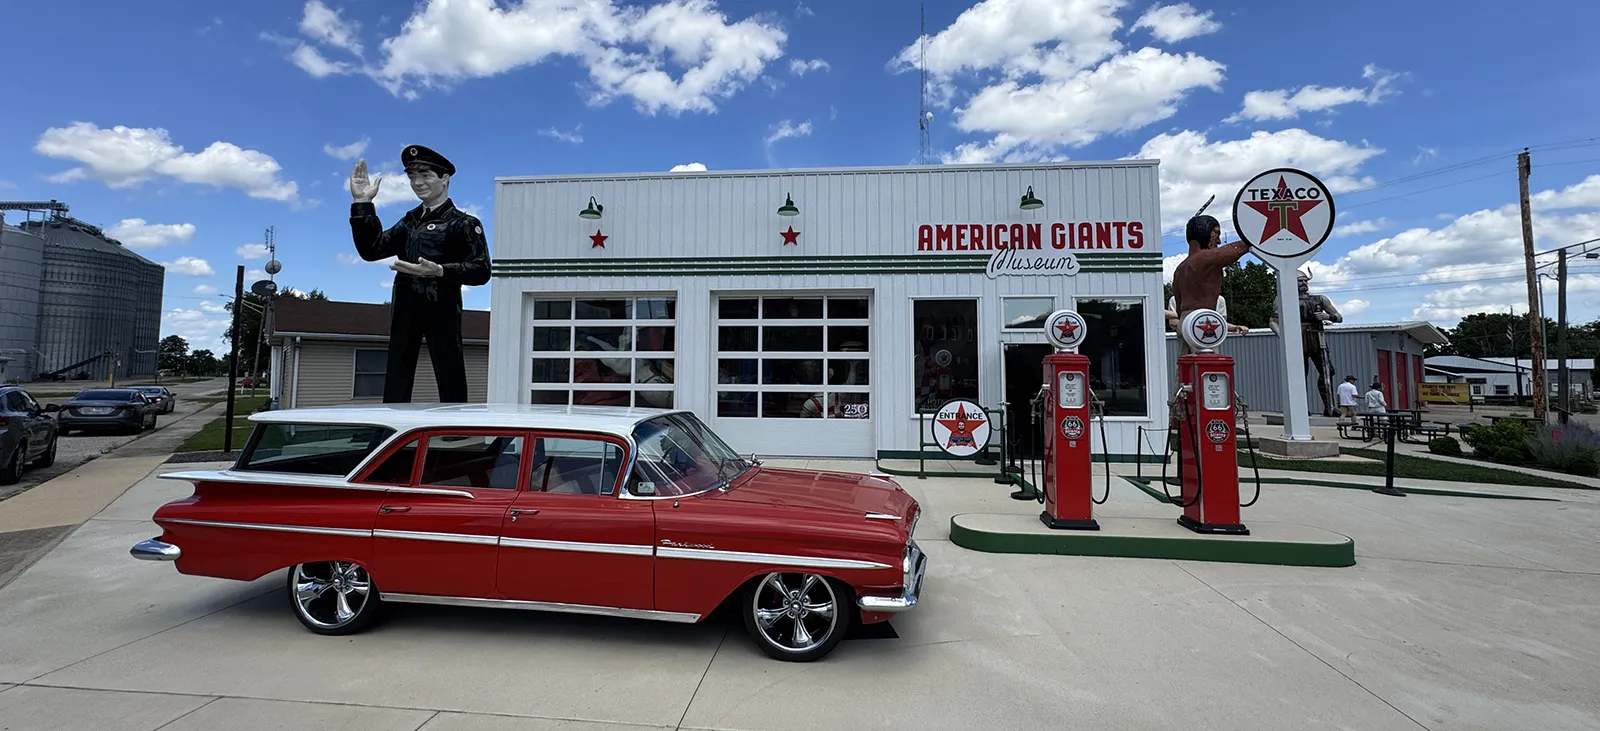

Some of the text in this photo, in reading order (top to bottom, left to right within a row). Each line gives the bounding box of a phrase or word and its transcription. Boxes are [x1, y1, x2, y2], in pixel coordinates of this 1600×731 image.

[1247, 187, 1321, 201] TEXACO
[917, 222, 1144, 251] AMERICAN GIANTS
[990, 245, 1075, 273] Museum
[843, 403, 868, 415] 250
[939, 412, 983, 420] ENTRANCE
